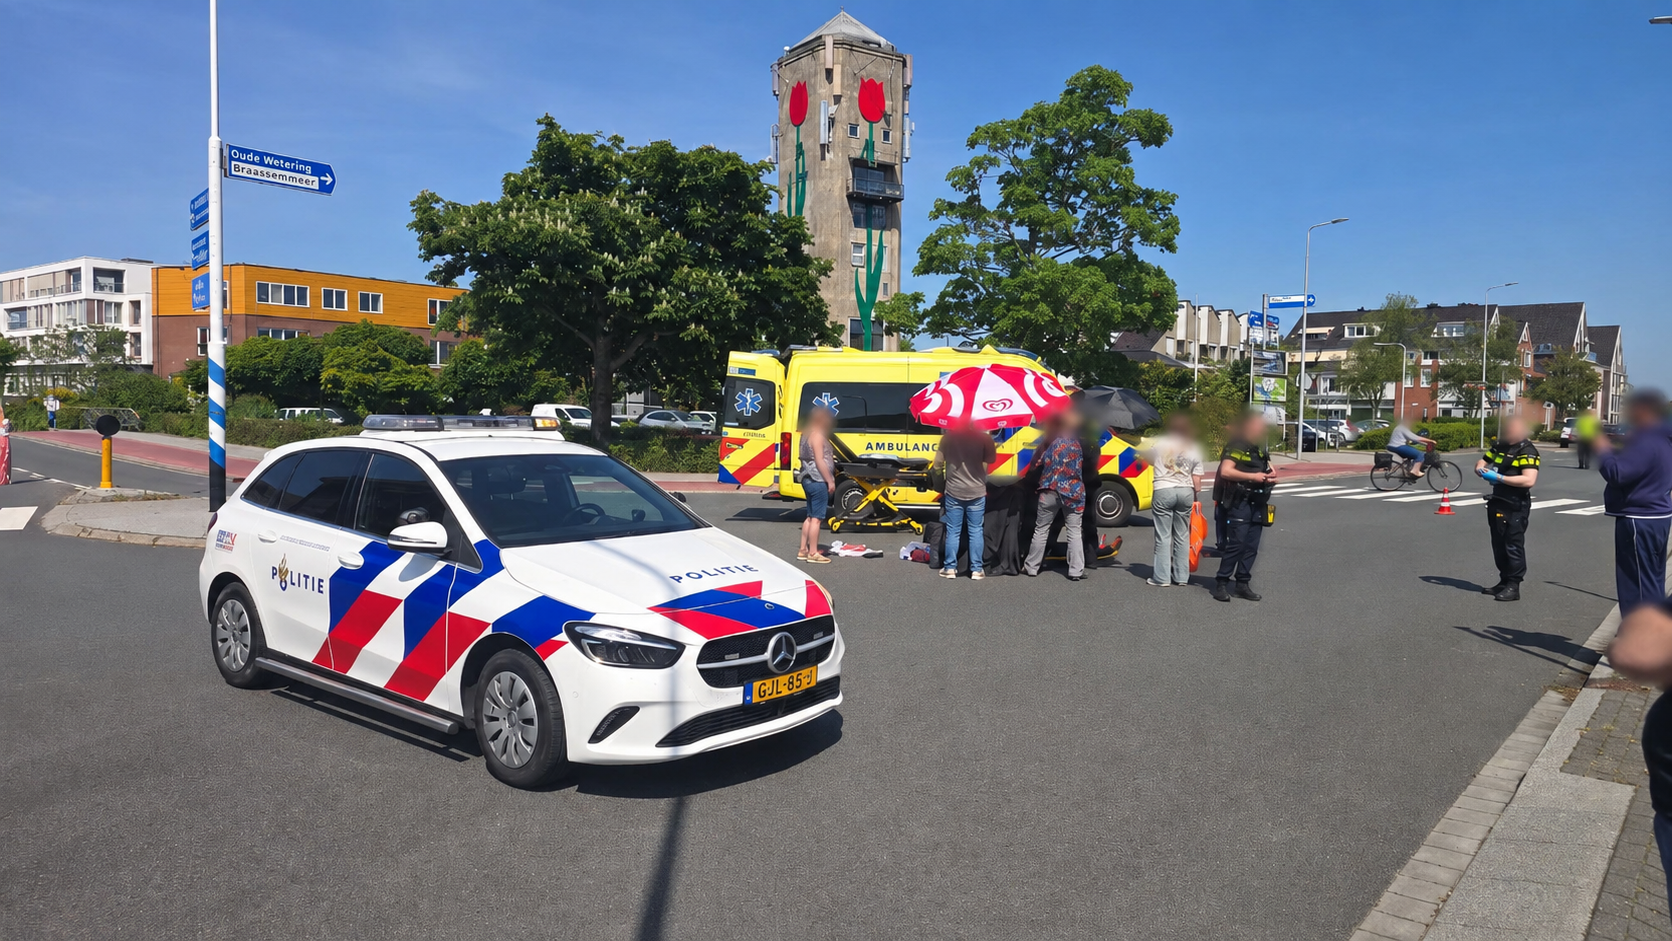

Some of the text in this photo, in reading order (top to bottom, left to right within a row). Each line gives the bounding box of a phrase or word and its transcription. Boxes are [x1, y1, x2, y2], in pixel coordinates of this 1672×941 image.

[231, 149, 312, 175] Oude Wetering
[233, 164, 316, 186] Braassemmeer
[865, 442, 939, 452] AMBULANC
[271, 566, 325, 594] POLITIE
[669, 564, 759, 584] POLITIE
[758, 669, 813, 699] GJL-85-J
